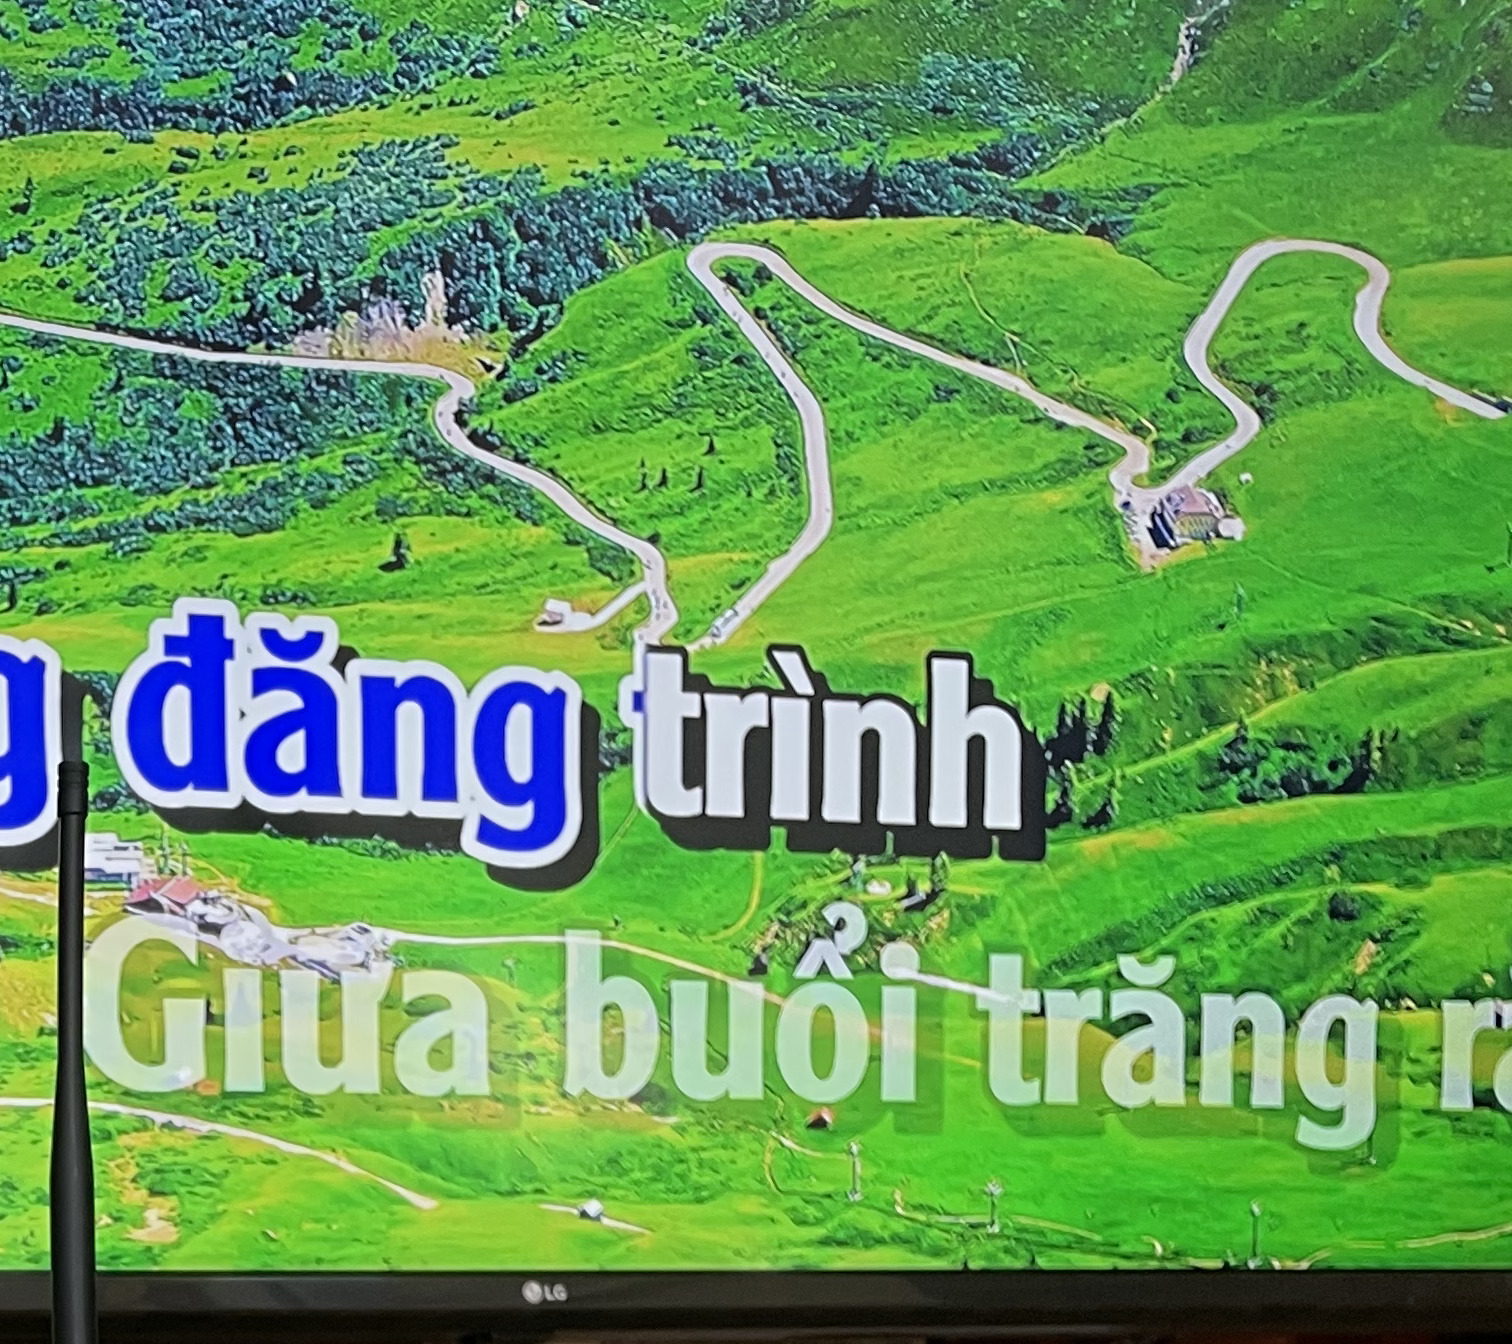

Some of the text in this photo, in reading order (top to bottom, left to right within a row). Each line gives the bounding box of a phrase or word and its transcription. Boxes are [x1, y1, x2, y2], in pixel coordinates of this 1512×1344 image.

[114, 598, 581, 868] đăng
[633, 646, 1023, 831] trình
[562, 901, 918, 1107] buổi
[976, 953, 1380, 1151] trăng
